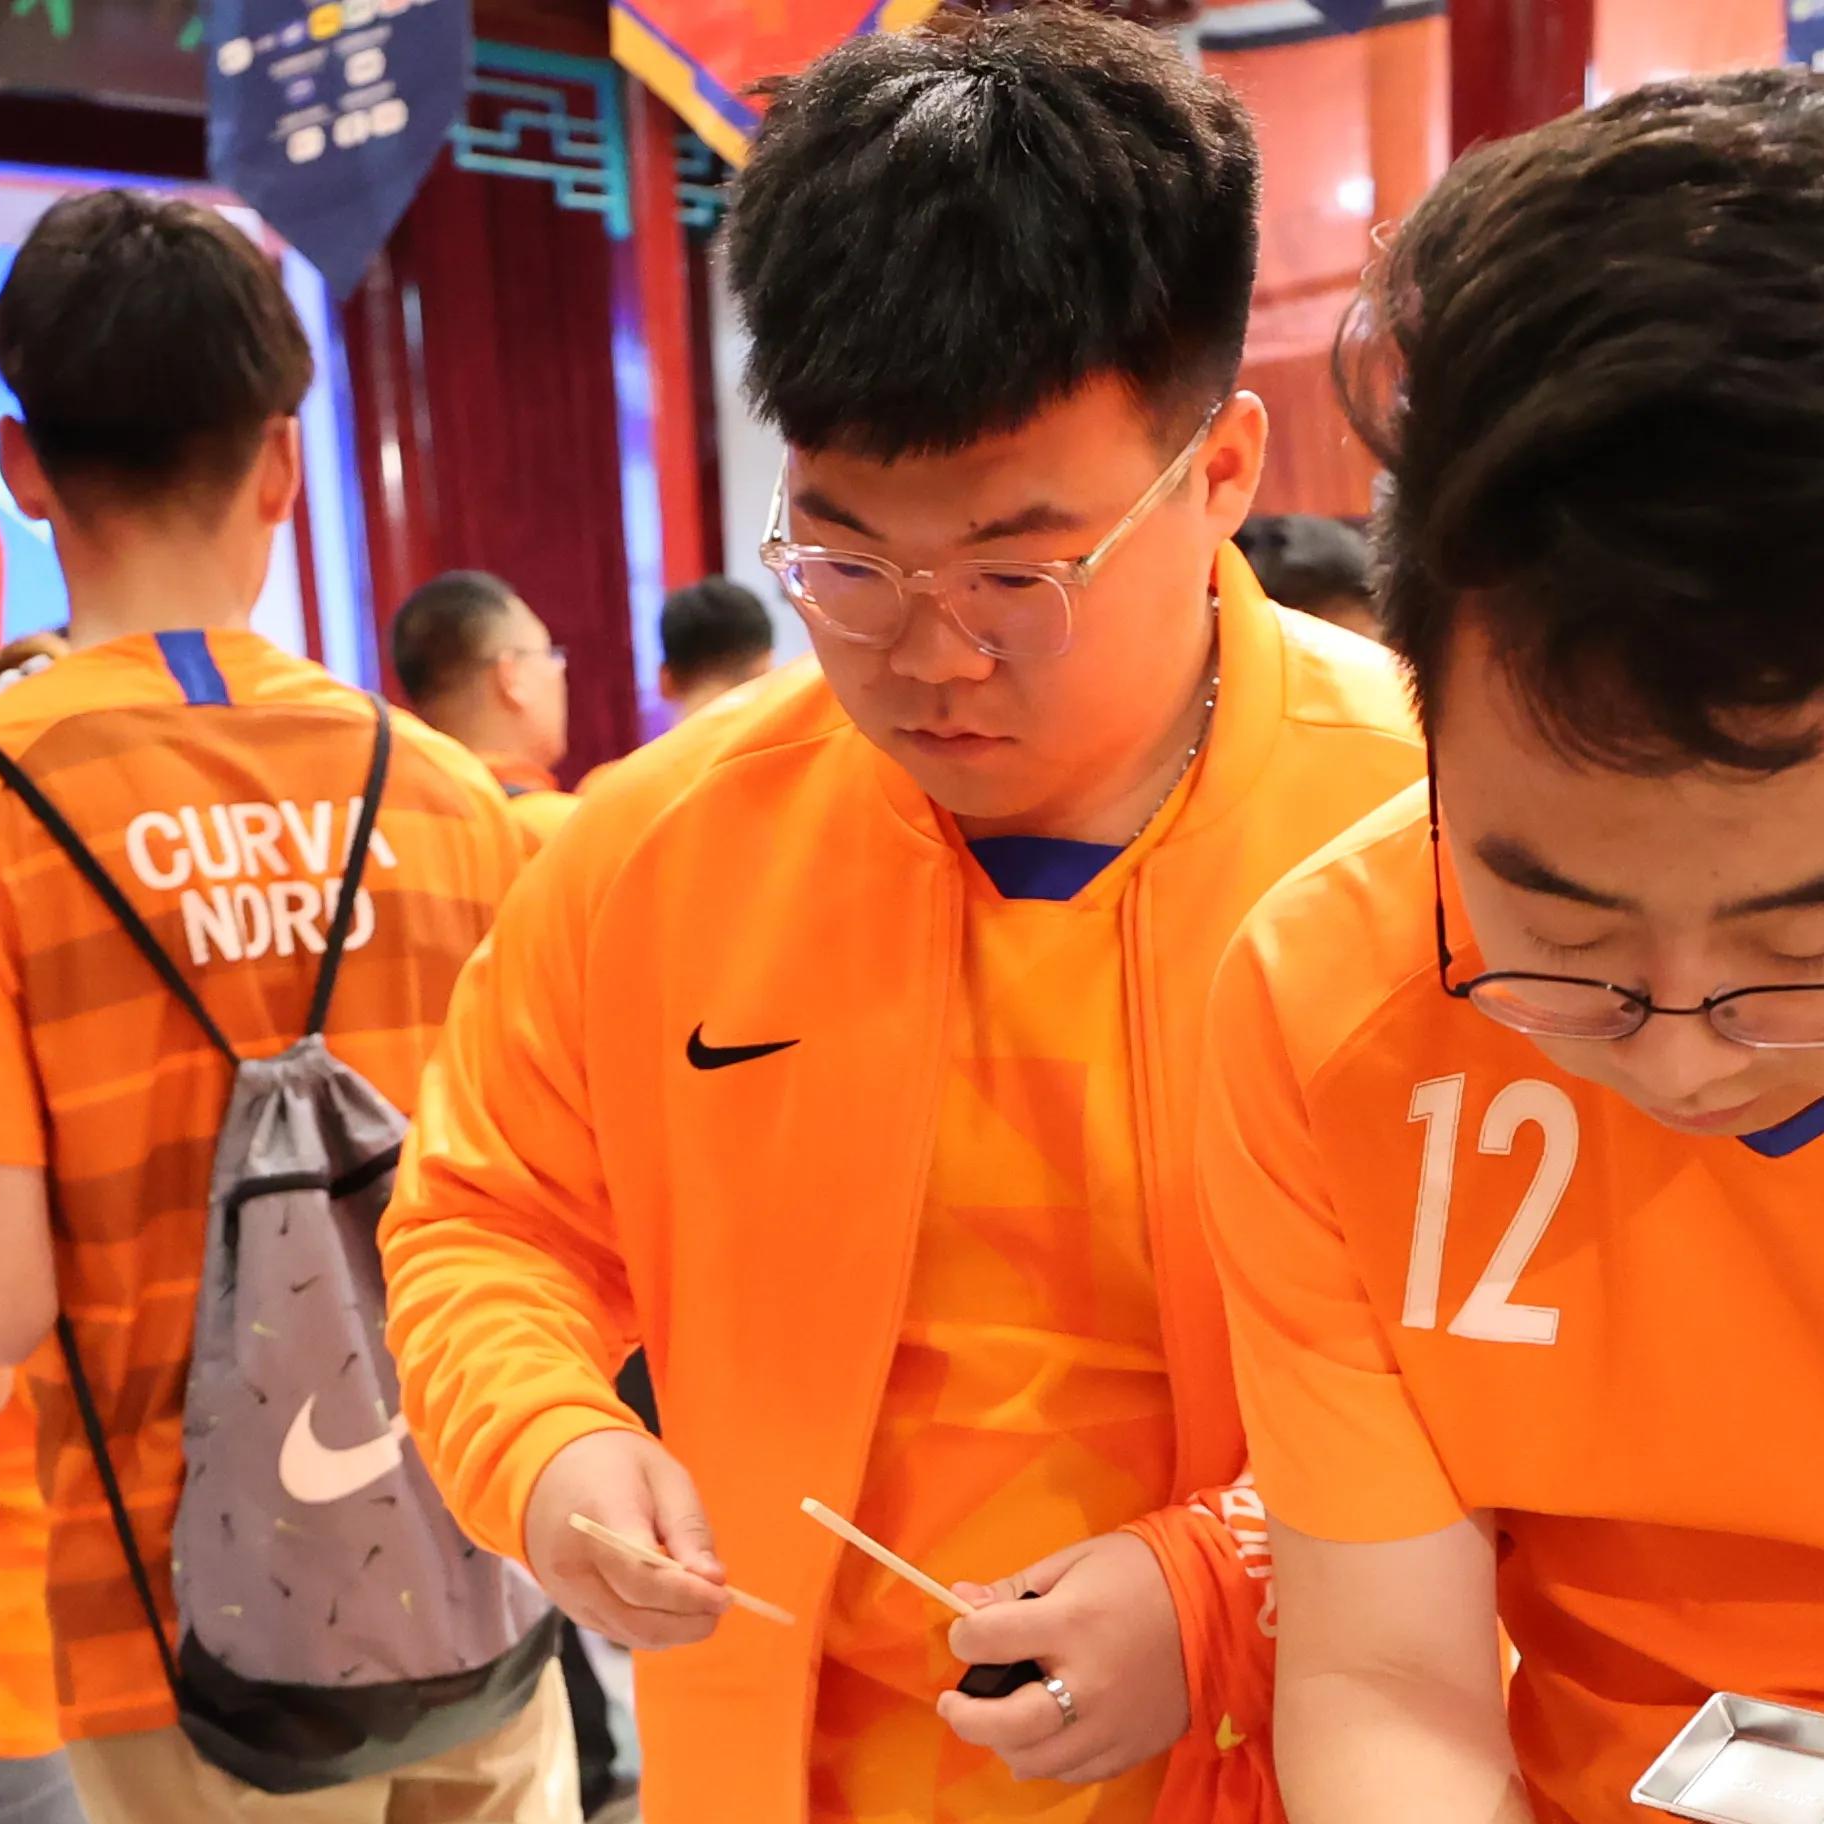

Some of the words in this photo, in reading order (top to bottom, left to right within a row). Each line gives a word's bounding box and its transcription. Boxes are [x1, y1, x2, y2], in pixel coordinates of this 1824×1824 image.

[126, 795, 398, 891] CURVA
[180, 878, 375, 966] NORD
[1402, 1072, 1579, 1345] 12
